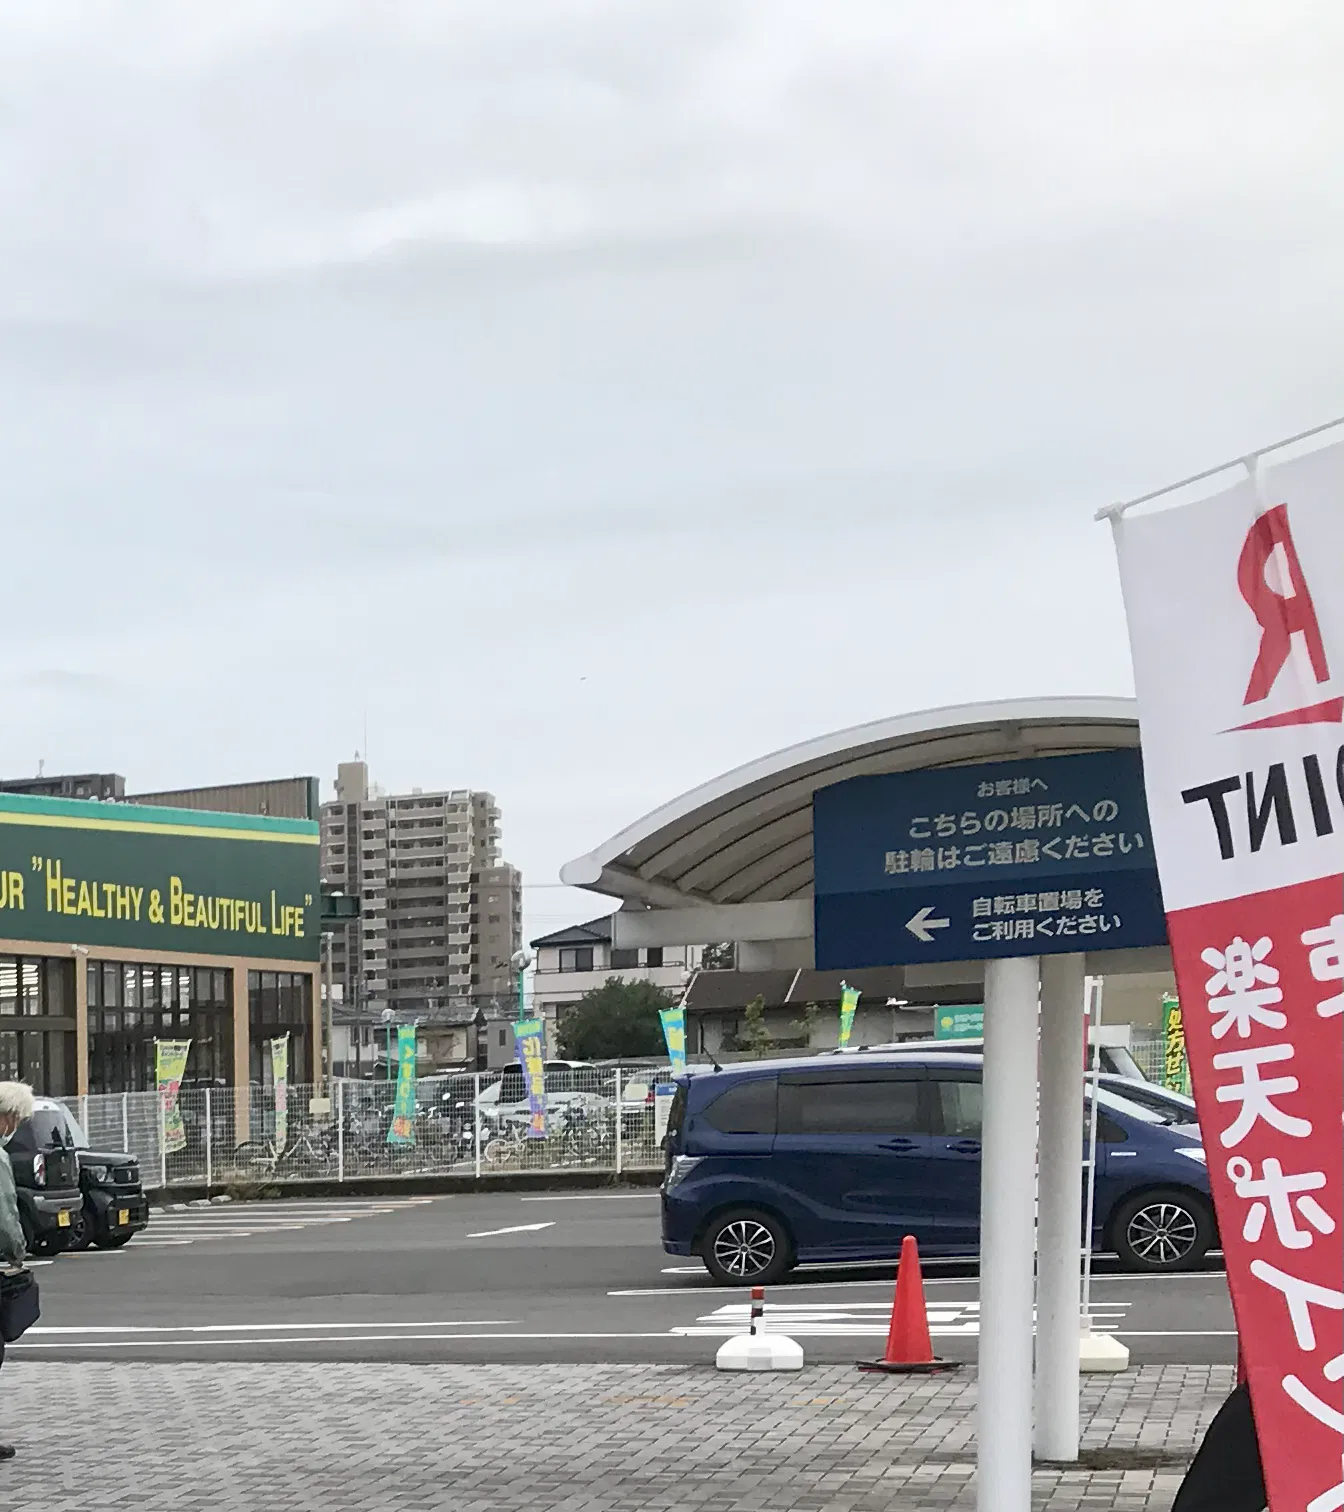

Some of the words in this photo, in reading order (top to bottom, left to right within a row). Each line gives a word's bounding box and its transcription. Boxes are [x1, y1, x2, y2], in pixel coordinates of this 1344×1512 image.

[977, 778, 1048, 797] お客様へ
[909, 799, 1119, 839] こちらの場所への
[884, 832, 1144, 875] 駐輪はご遠慮ください
[148, 889, 165, 924] &
[972, 888, 1105, 918] 自転車置場を
[972, 913, 1122, 942] ご利用ください
